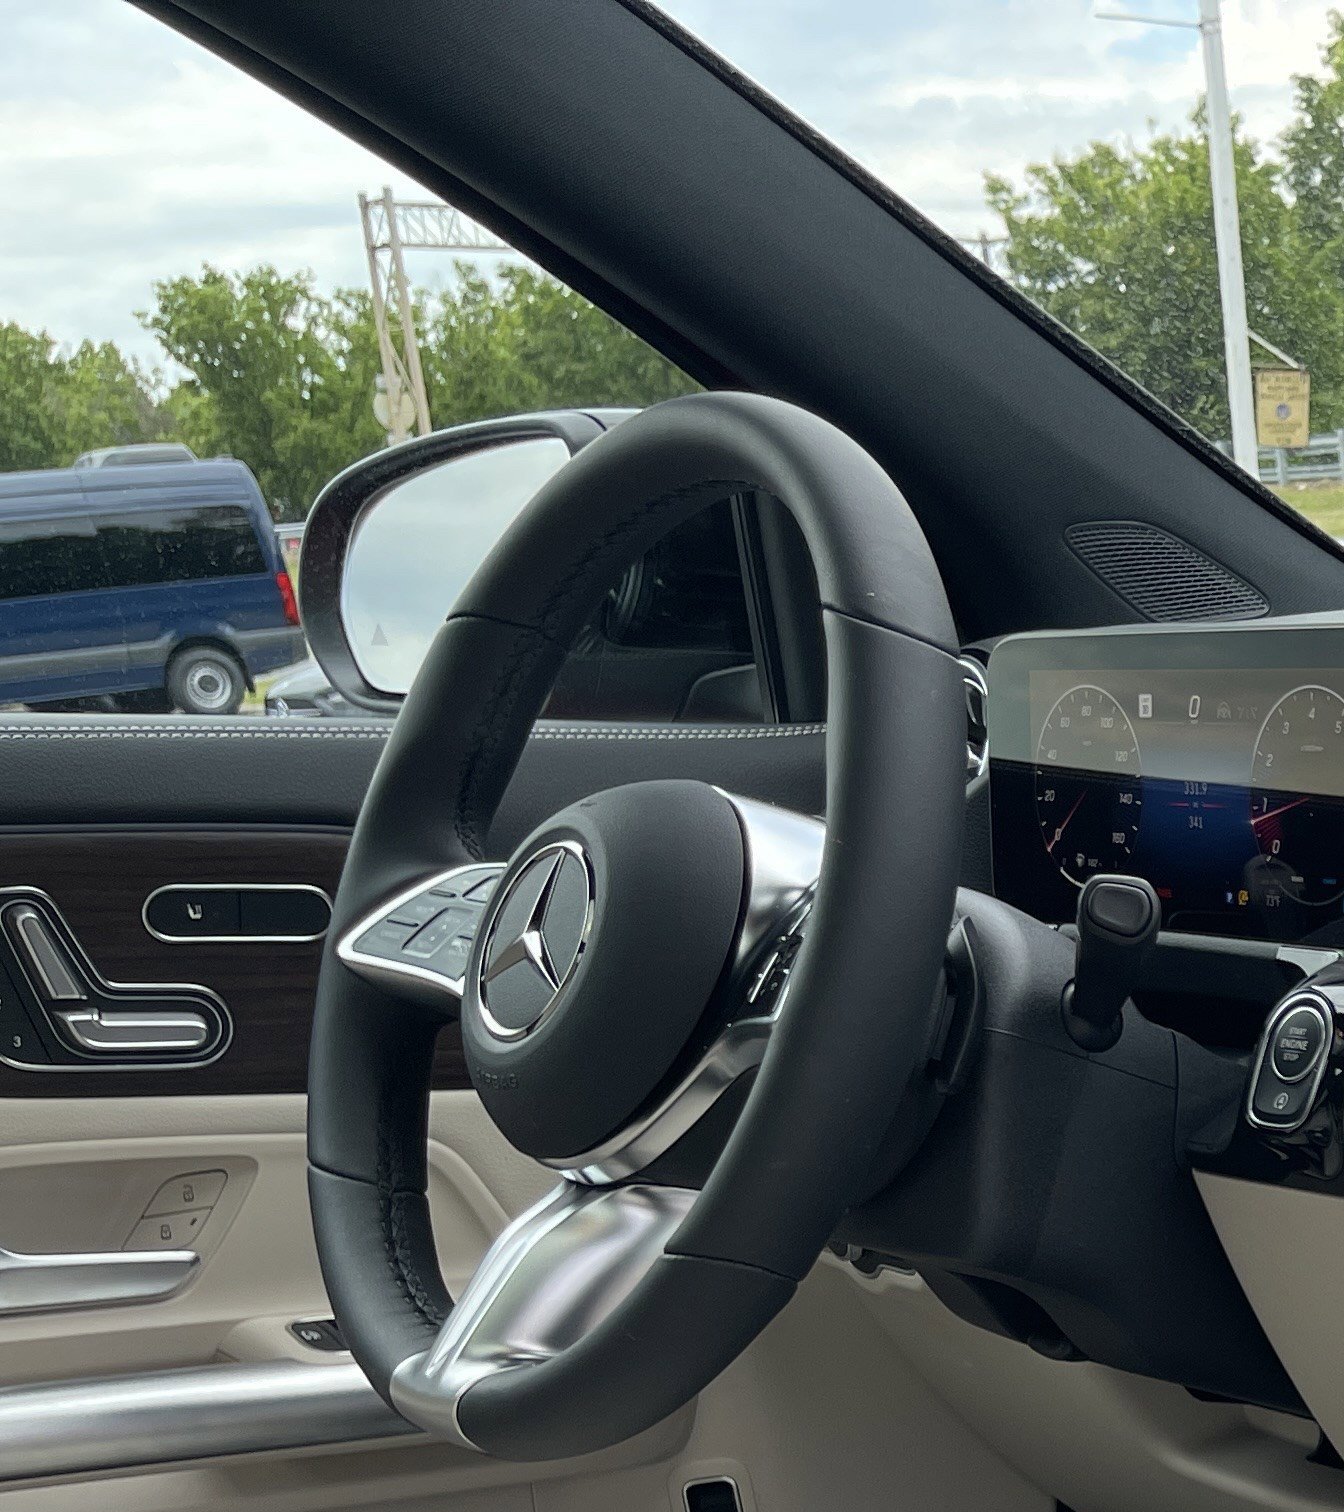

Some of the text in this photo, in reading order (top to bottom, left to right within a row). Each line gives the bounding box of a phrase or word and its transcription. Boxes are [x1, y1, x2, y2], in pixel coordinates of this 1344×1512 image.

[1189, 695, 1200, 718] 0
[1309, 707, 1315, 719] 4
[1283, 722, 1290, 735] 3
[1335, 721, 1342, 734] 5
[1266, 754, 1273, 767] 2
[1045, 790, 1055, 801] 20
[1272, 839, 1280, 854] 0
